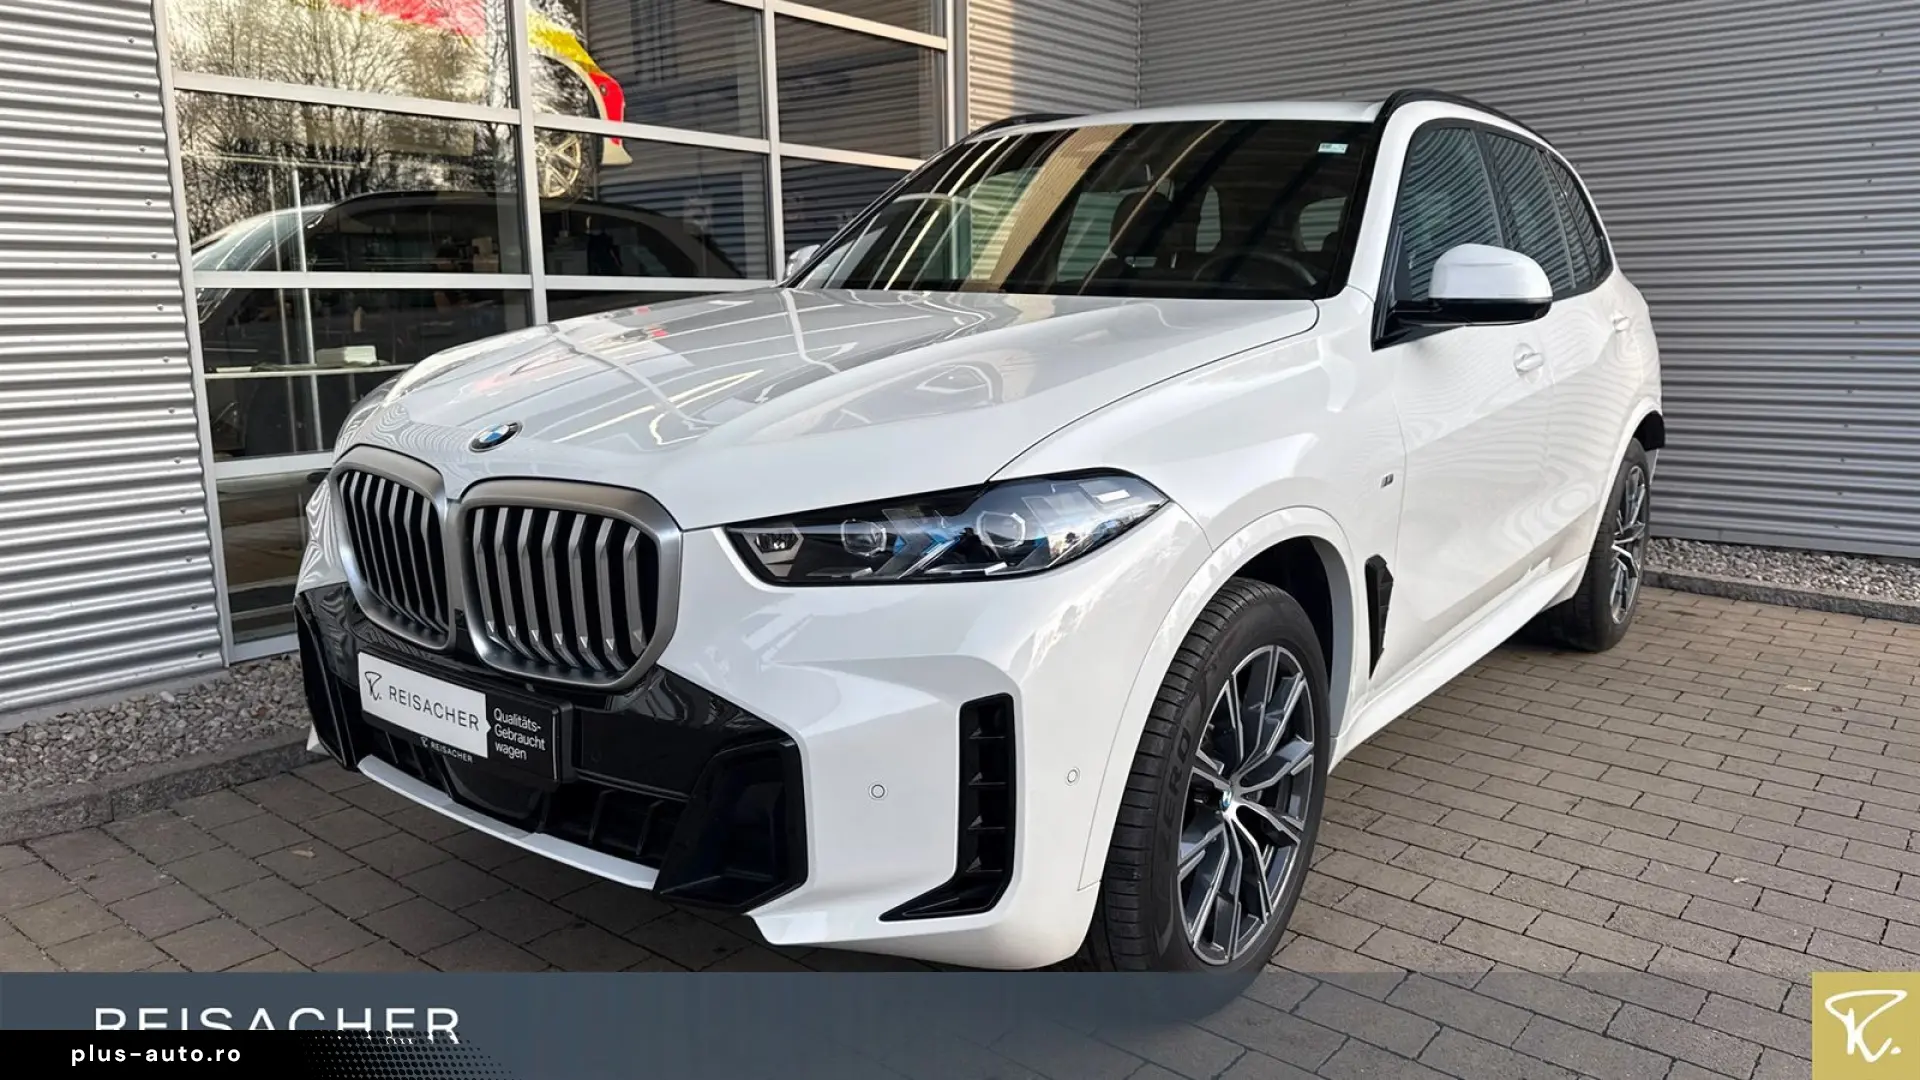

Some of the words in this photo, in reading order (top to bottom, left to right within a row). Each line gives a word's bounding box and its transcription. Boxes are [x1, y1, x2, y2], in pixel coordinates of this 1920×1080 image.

[388, 686, 480, 731] REISACHER
[493, 707, 541, 732] Qualitäts-
[494, 725, 546, 750] Gebraucht
[430, 742, 473, 763] REISACHER
[494, 742, 527, 760] wagen
